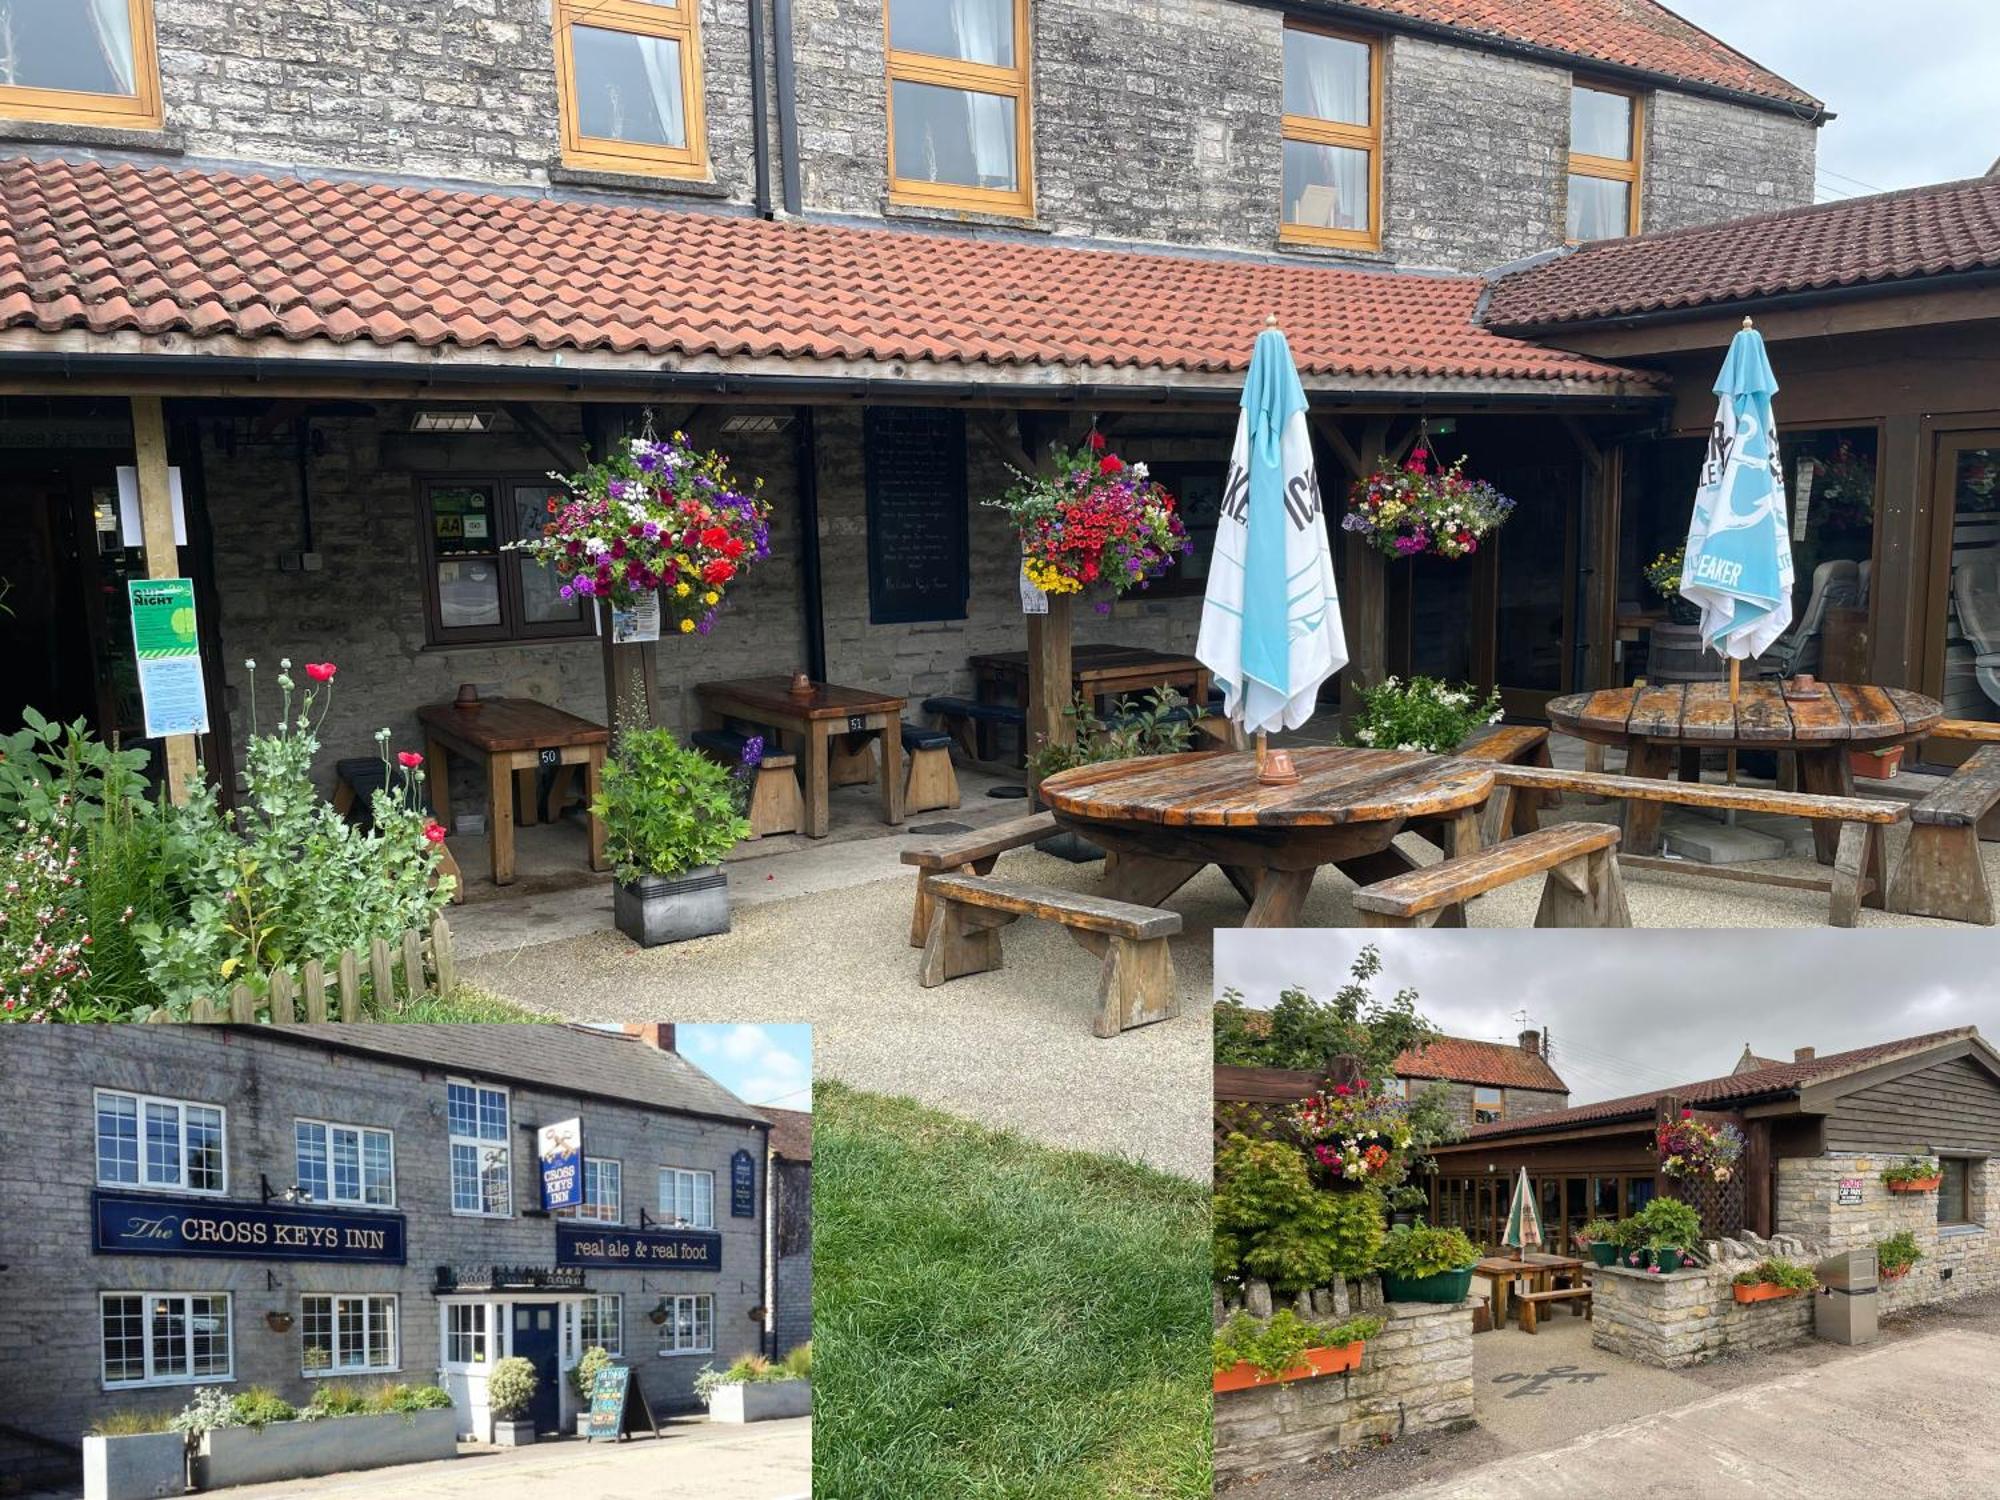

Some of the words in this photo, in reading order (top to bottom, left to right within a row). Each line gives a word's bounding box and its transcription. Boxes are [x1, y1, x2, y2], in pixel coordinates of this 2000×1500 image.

[134, 596, 173, 606] NIGHT
[542, 750, 556, 763] 50
[544, 1164, 575, 1182] CROSS
[547, 1178, 573, 1193] KEYS
[551, 1190, 569, 1204] INN
[120, 1216, 178, 1239] The
[181, 1218, 267, 1244] CROSS
[273, 1224, 338, 1248] KEYS
[345, 1229, 385, 1250] INN
[574, 1239, 605, 1257] real
[608, 1240, 630, 1258] ale
[635, 1241, 648, 1258] &
[651, 1243, 678, 1259] real
[681, 1243, 708, 1260] food
